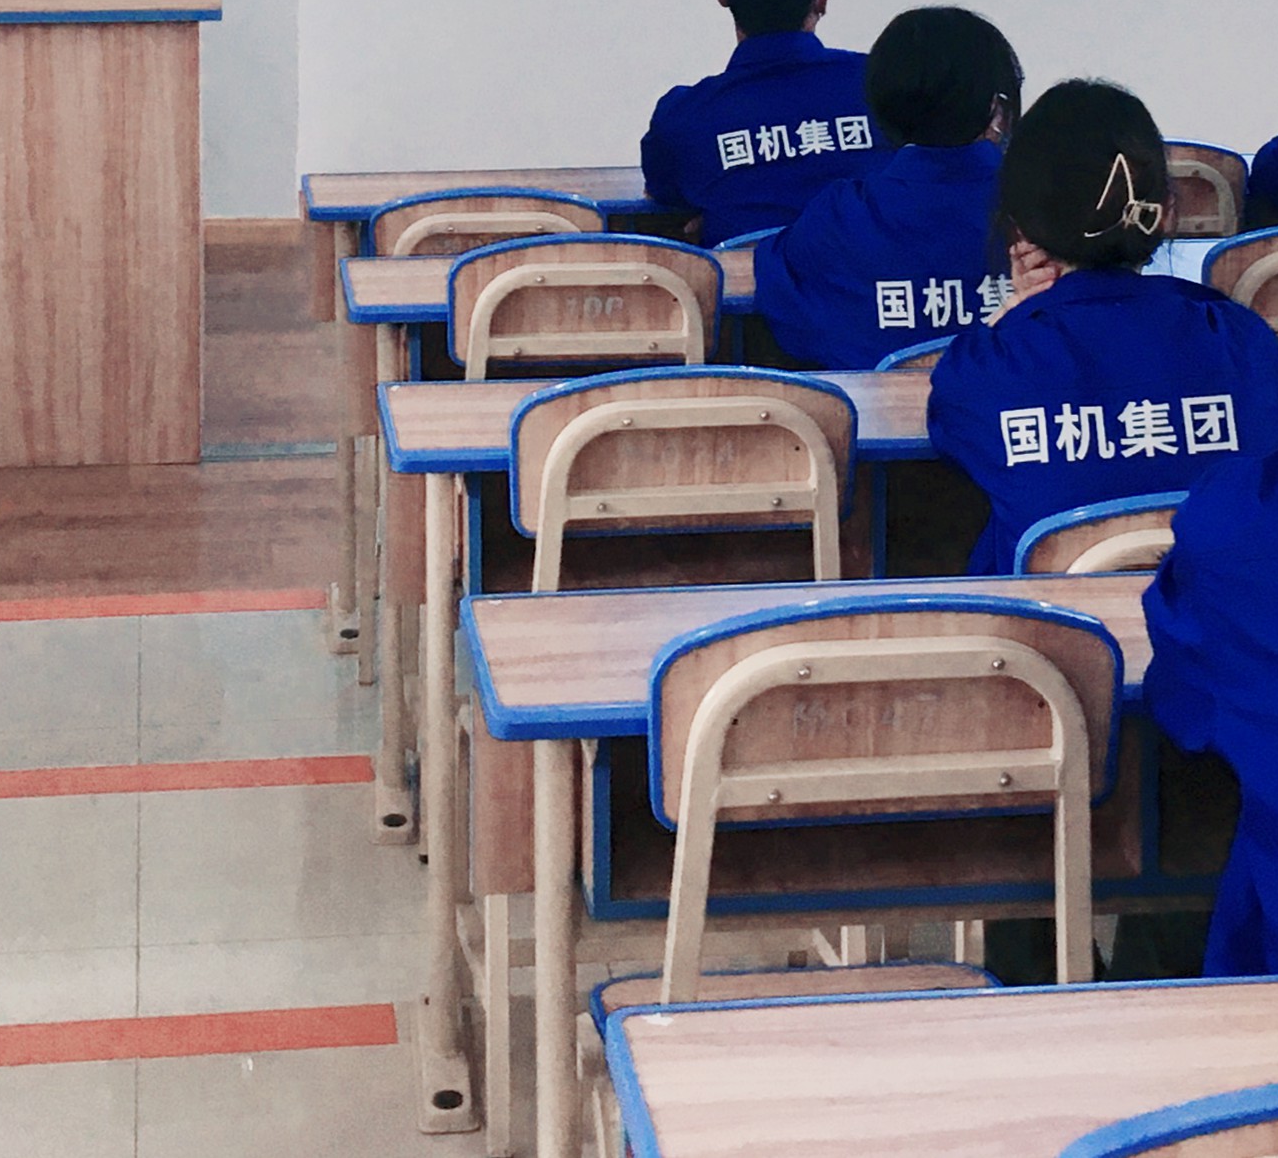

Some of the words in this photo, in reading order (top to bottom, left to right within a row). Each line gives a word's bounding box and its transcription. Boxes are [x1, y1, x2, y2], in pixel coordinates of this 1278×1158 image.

[717, 115, 873, 171] 国机集团
[1001, 394, 1239, 467] 国机集团
